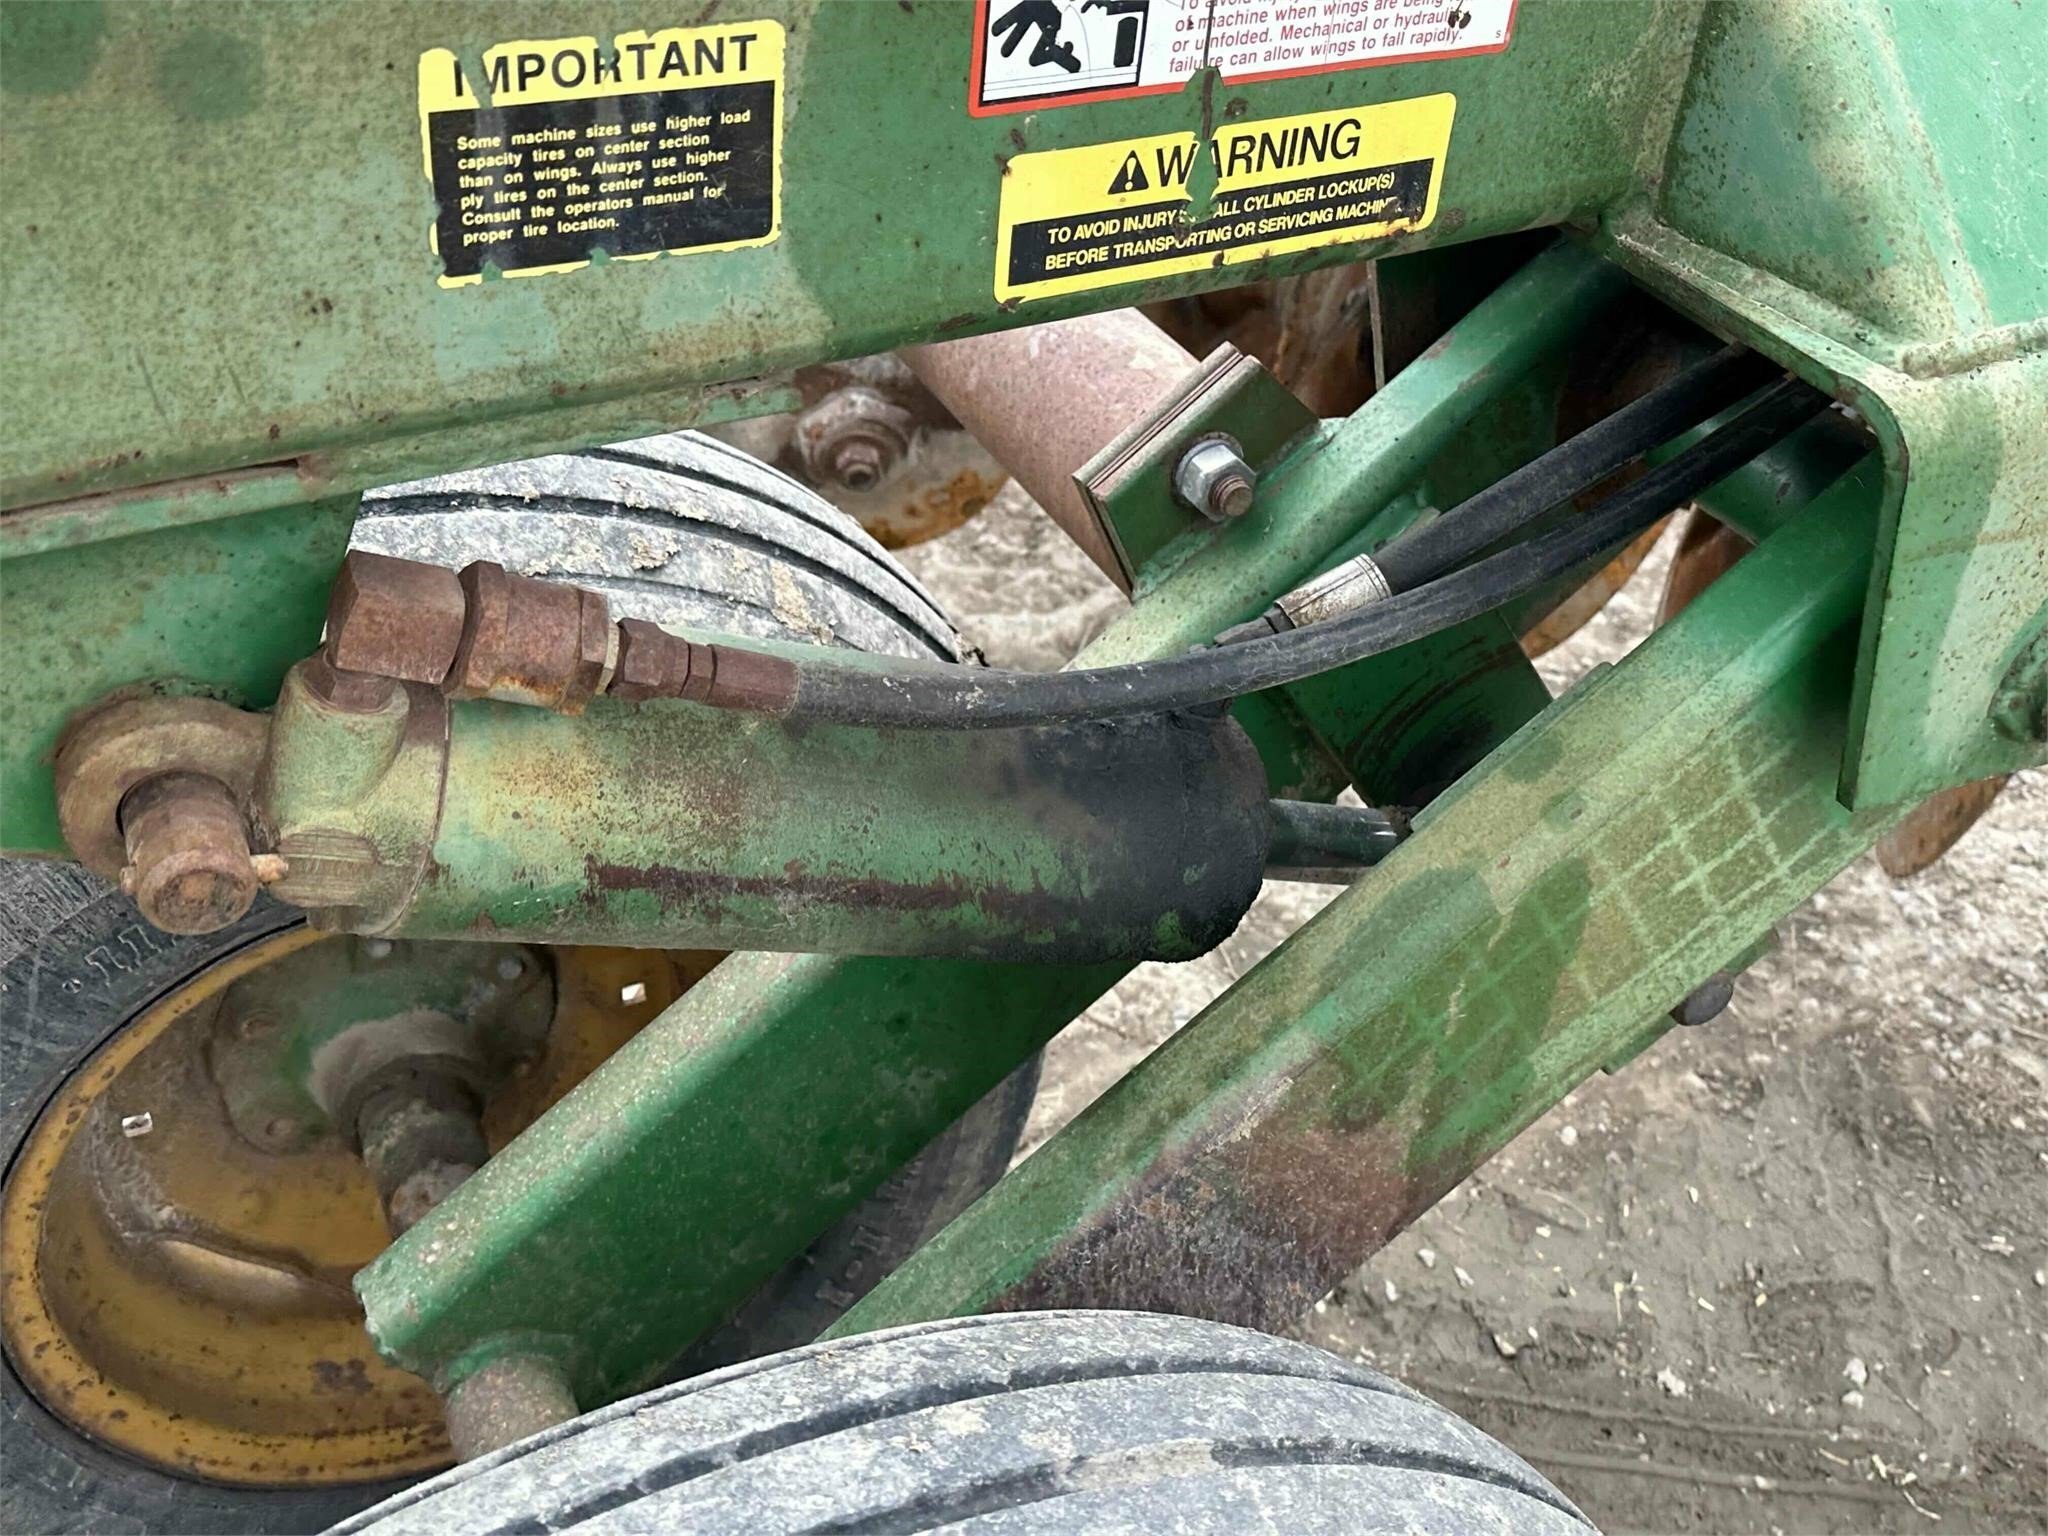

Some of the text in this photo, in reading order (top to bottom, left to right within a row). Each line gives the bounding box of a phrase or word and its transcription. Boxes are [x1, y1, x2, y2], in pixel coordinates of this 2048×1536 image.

[1172, 40, 1189, 53] or
[1195, 28, 1273, 51] unfolded.
[1280, 18, 1367, 41] Mechanical
[1373, 17, 1389, 31] or
[1198, 9, 1268, 30] machine
[1275, 5, 1316, 21] when
[1323, 1, 1368, 18] wings
[1374, 0, 1397, 10] are
[1169, 28, 1463, 73] failure can allow wings to fall rapidly.
[457, 109, 751, 151] Some machine sizes use higher load
[457, 133, 710, 171] capacity tires on center section
[459, 149, 732, 189] than on wings. Always use higher
[460, 170, 709, 210] ply tires on the center section.
[461, 185, 724, 226] Consult the operators manual for
[1048, 226, 1072, 244] TO
[1073, 219, 1120, 241] AVOID
[1123, 209, 1177, 233] INJURY
[1243, 187, 1315, 214] CYLINDER
[1318, 171, 1395, 201] LOCKUP(S)
[463, 216, 620, 247] proper tire location.
[1045, 246, 1109, 271] BEFORE
[1233, 220, 1256, 239] OR
[1258, 204, 1334, 235] SERVICING
[1335, 195, 1398, 220] MACHIN
